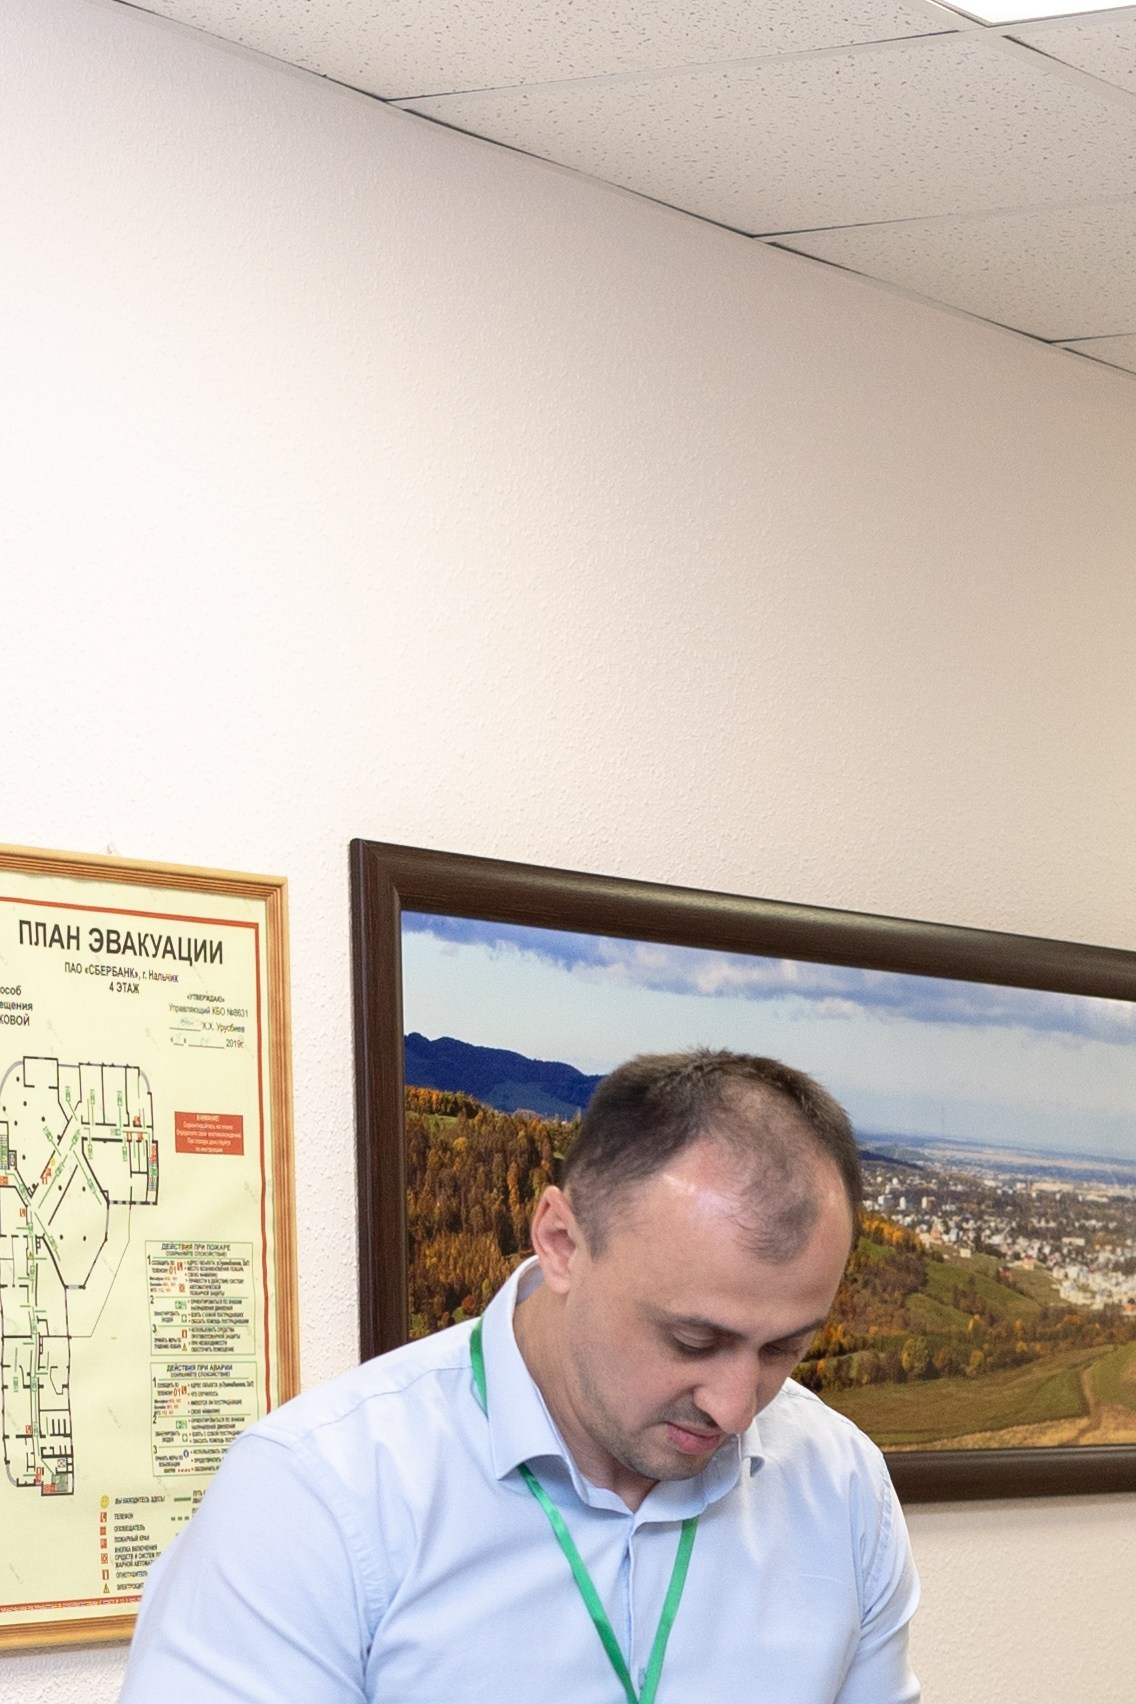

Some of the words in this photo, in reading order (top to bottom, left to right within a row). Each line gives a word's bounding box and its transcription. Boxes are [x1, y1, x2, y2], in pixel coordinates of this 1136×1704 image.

[19, 919, 80, 951] ПЛАН
[88, 927, 223, 967] ЭВАКУАЦИИ
[64, 961, 82, 974] ПАО
[148, 969, 179, 983] Нальчик
[109, 981, 114, 992] 4
[116, 982, 140, 994] ЭТАЖ
